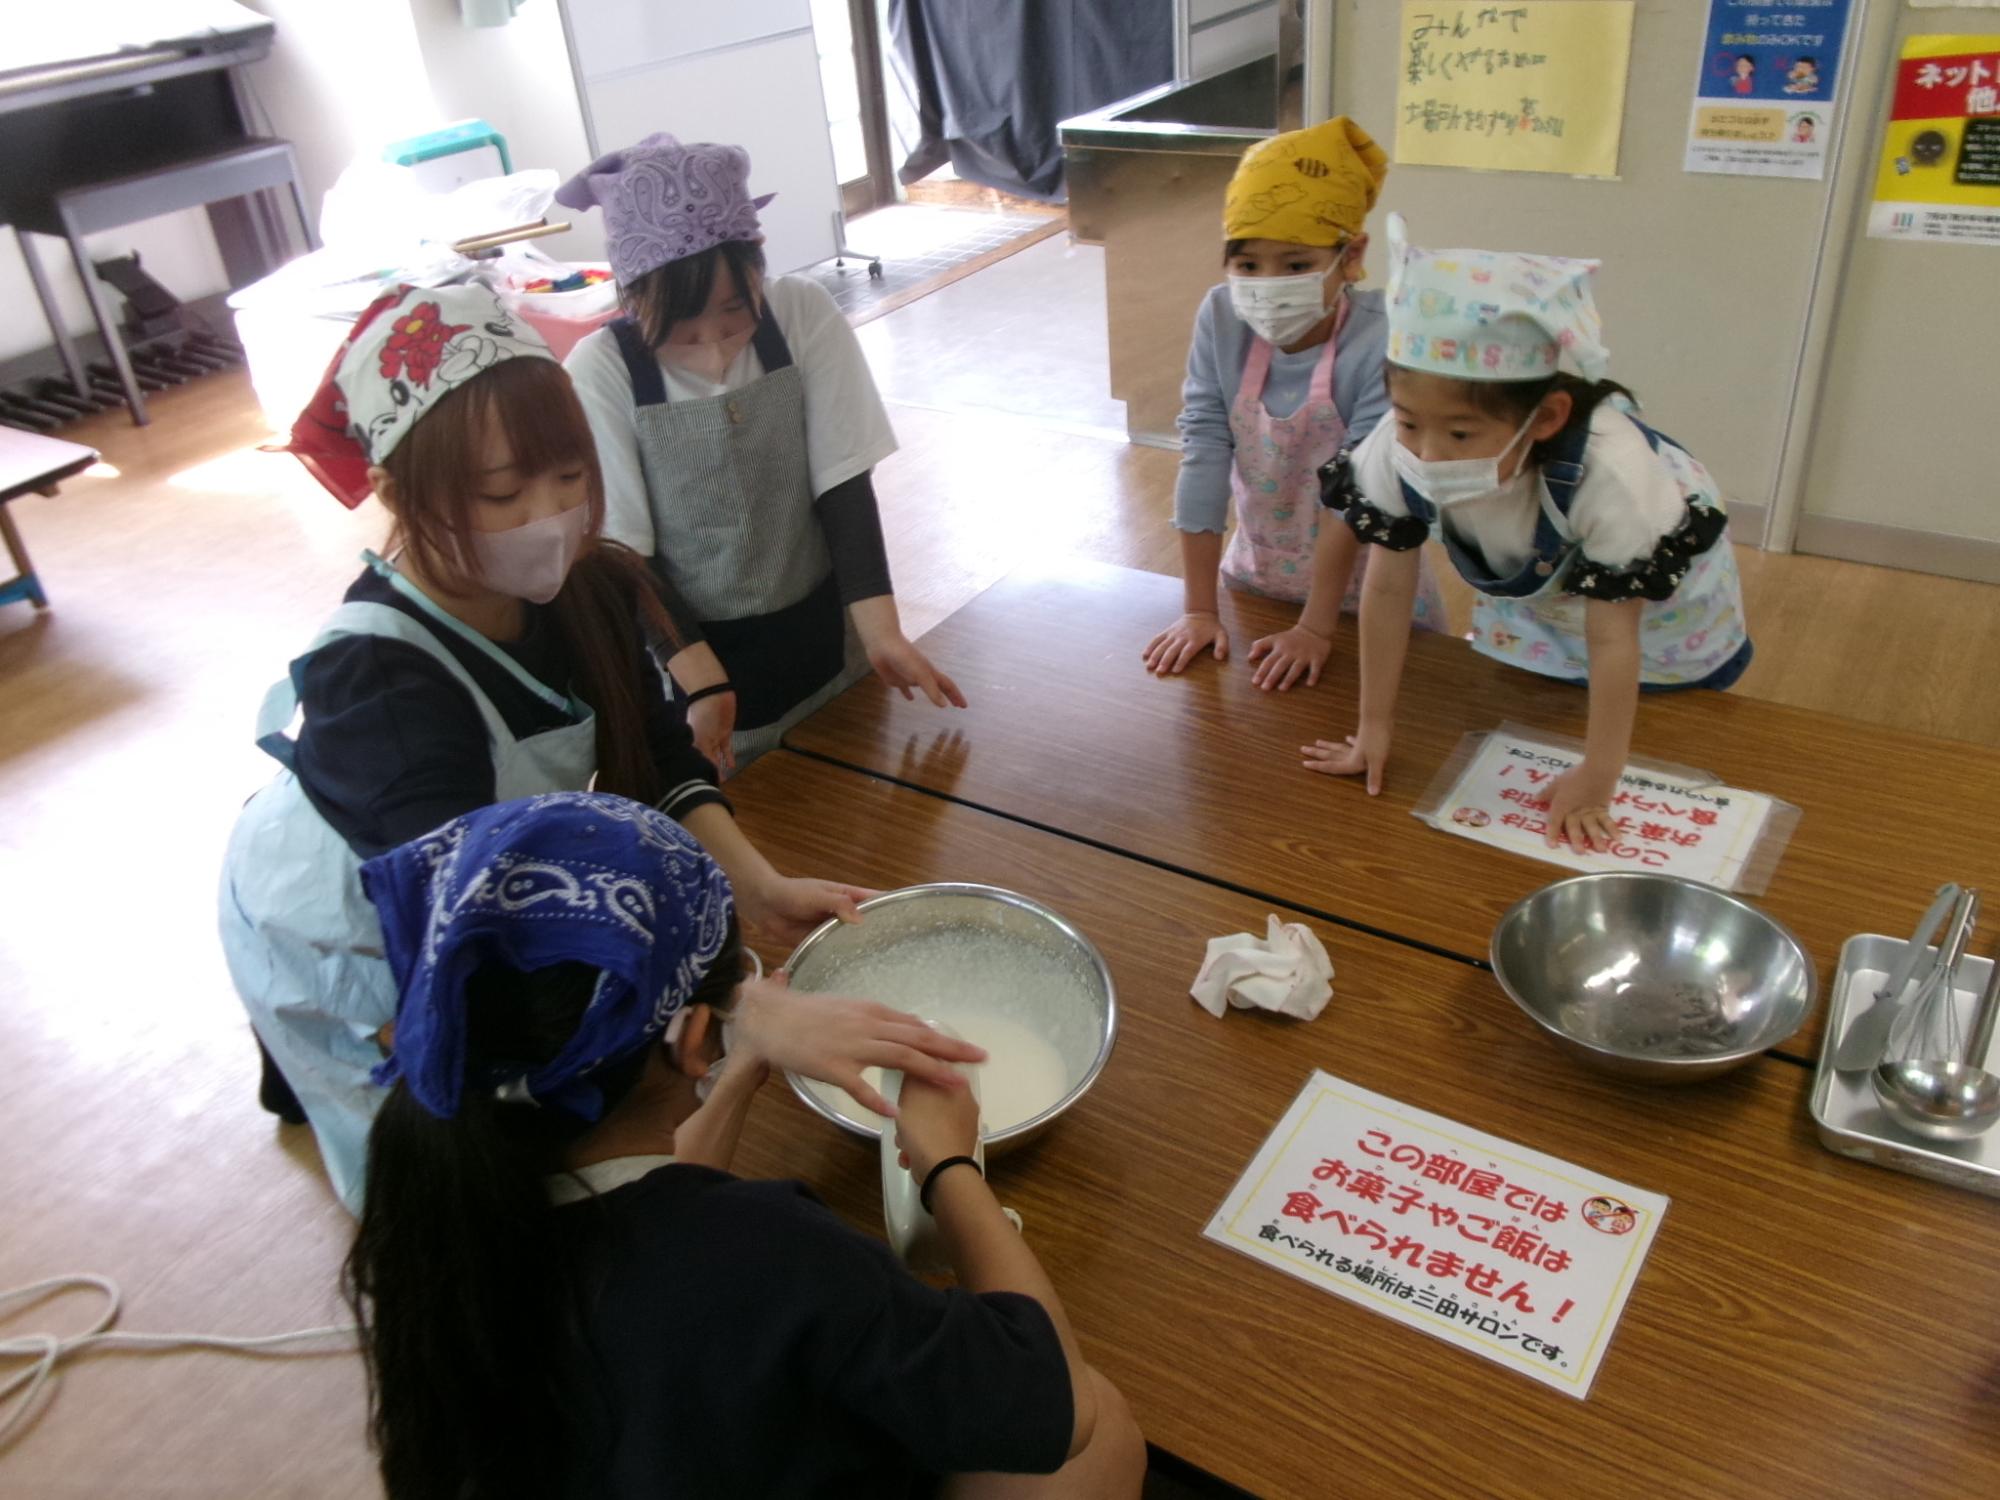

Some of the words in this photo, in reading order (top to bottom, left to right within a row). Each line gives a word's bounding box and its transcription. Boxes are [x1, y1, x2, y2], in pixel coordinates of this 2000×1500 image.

[1311, 1157, 1573, 1275] お菓子やご飯は
[1357, 1129, 1569, 1223] この部屋では
[1257, 1224, 1568, 1368] 食べられる場所は三田サロンです。
[1280, 1191, 1576, 1324] 食べられません！
